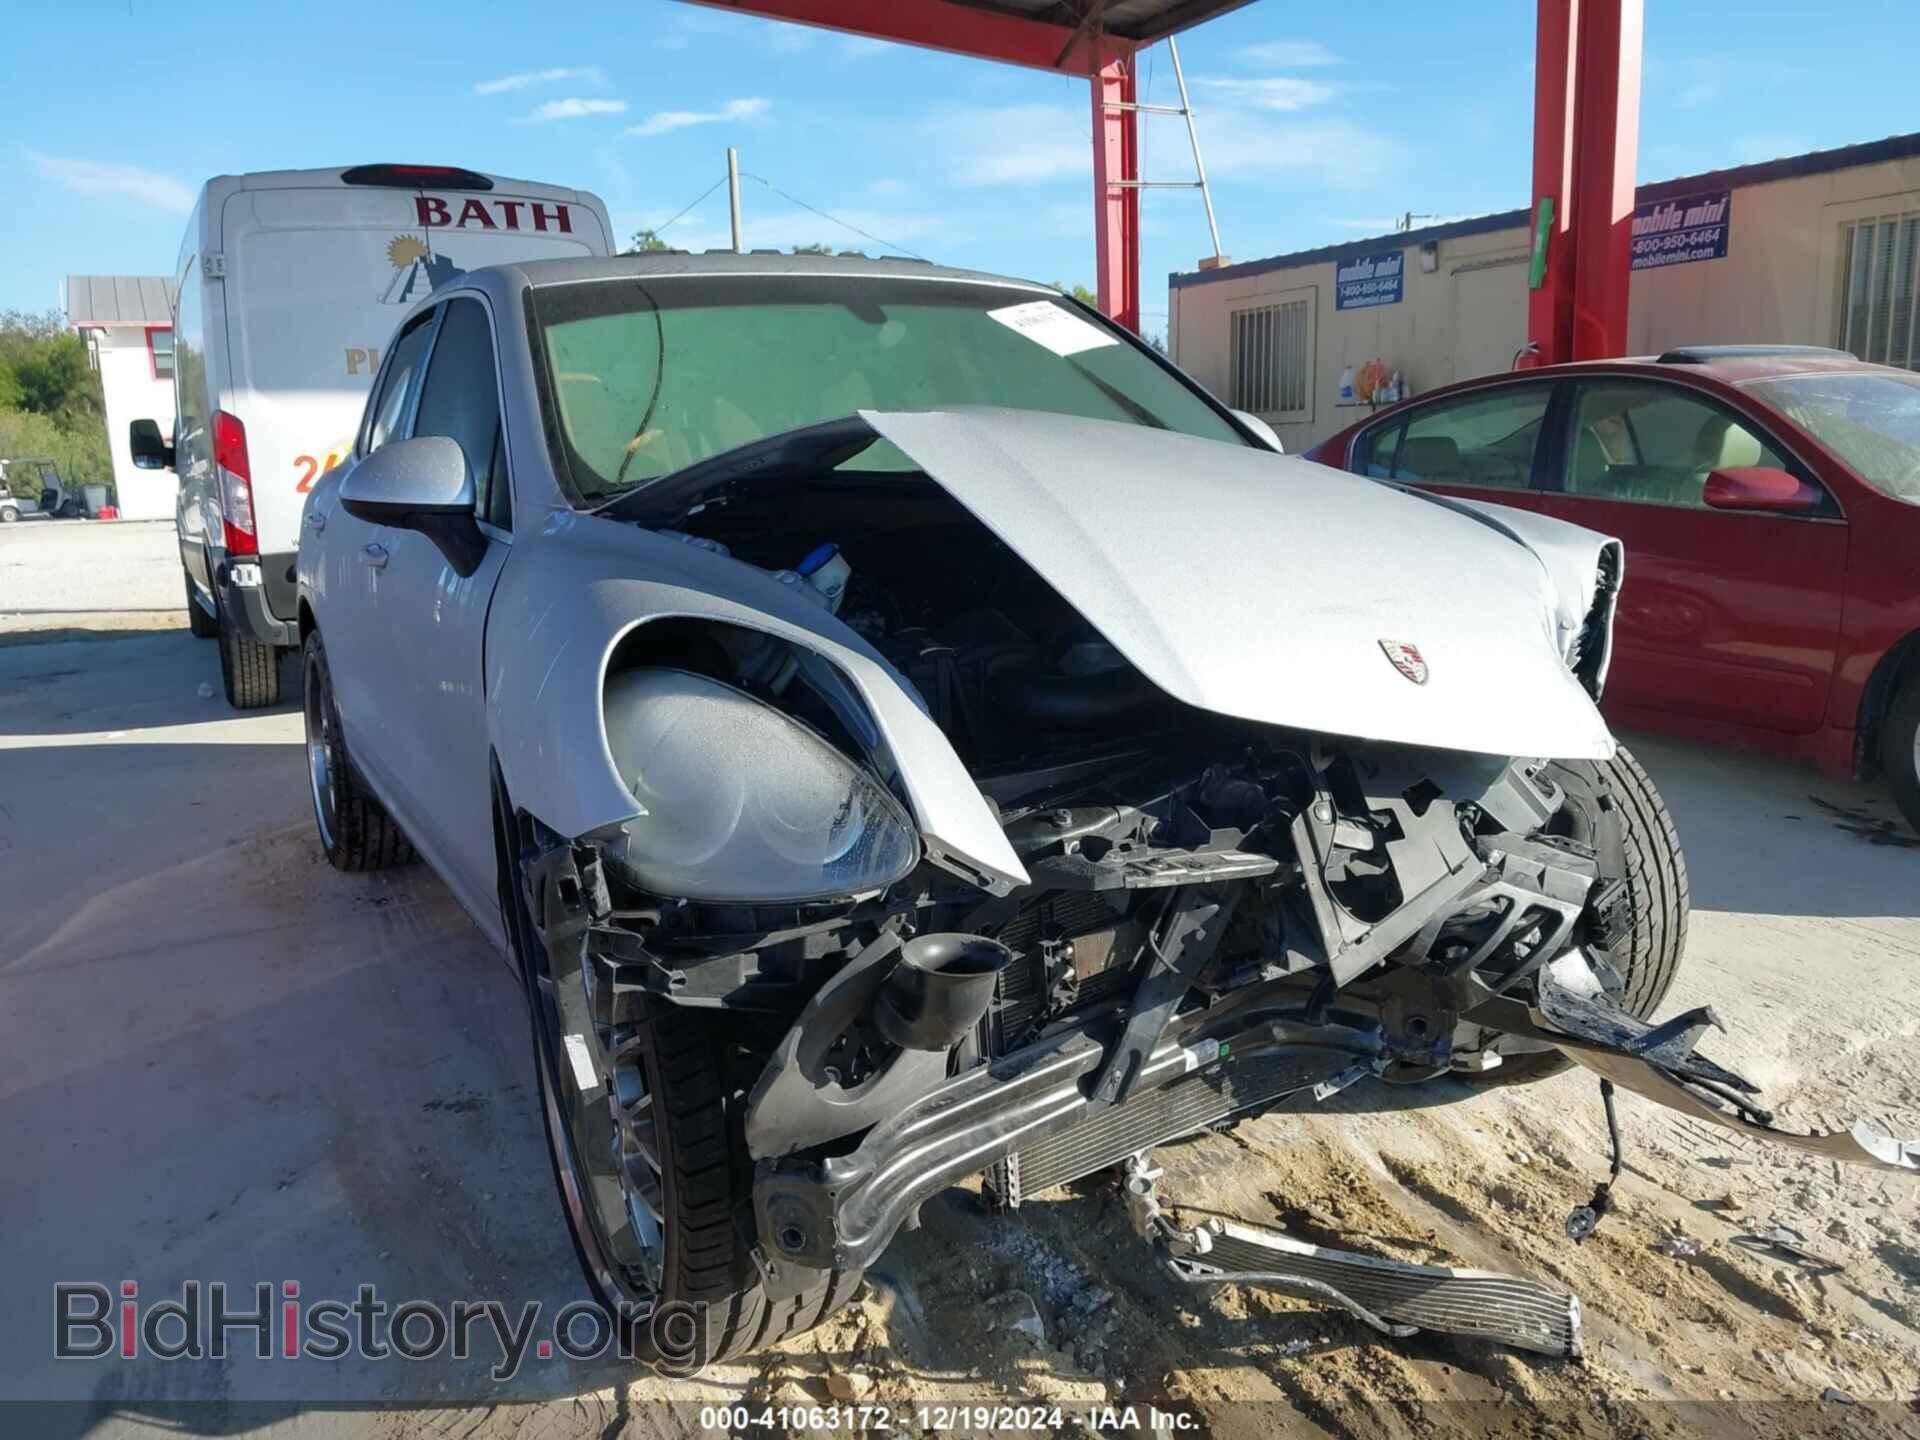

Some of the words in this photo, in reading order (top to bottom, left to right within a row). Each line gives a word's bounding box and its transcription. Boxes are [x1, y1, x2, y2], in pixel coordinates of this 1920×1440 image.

[414, 196, 573, 234] BATH
[1684, 196, 1728, 227] mini
[1632, 228, 1720, 254] -800-950-6464
